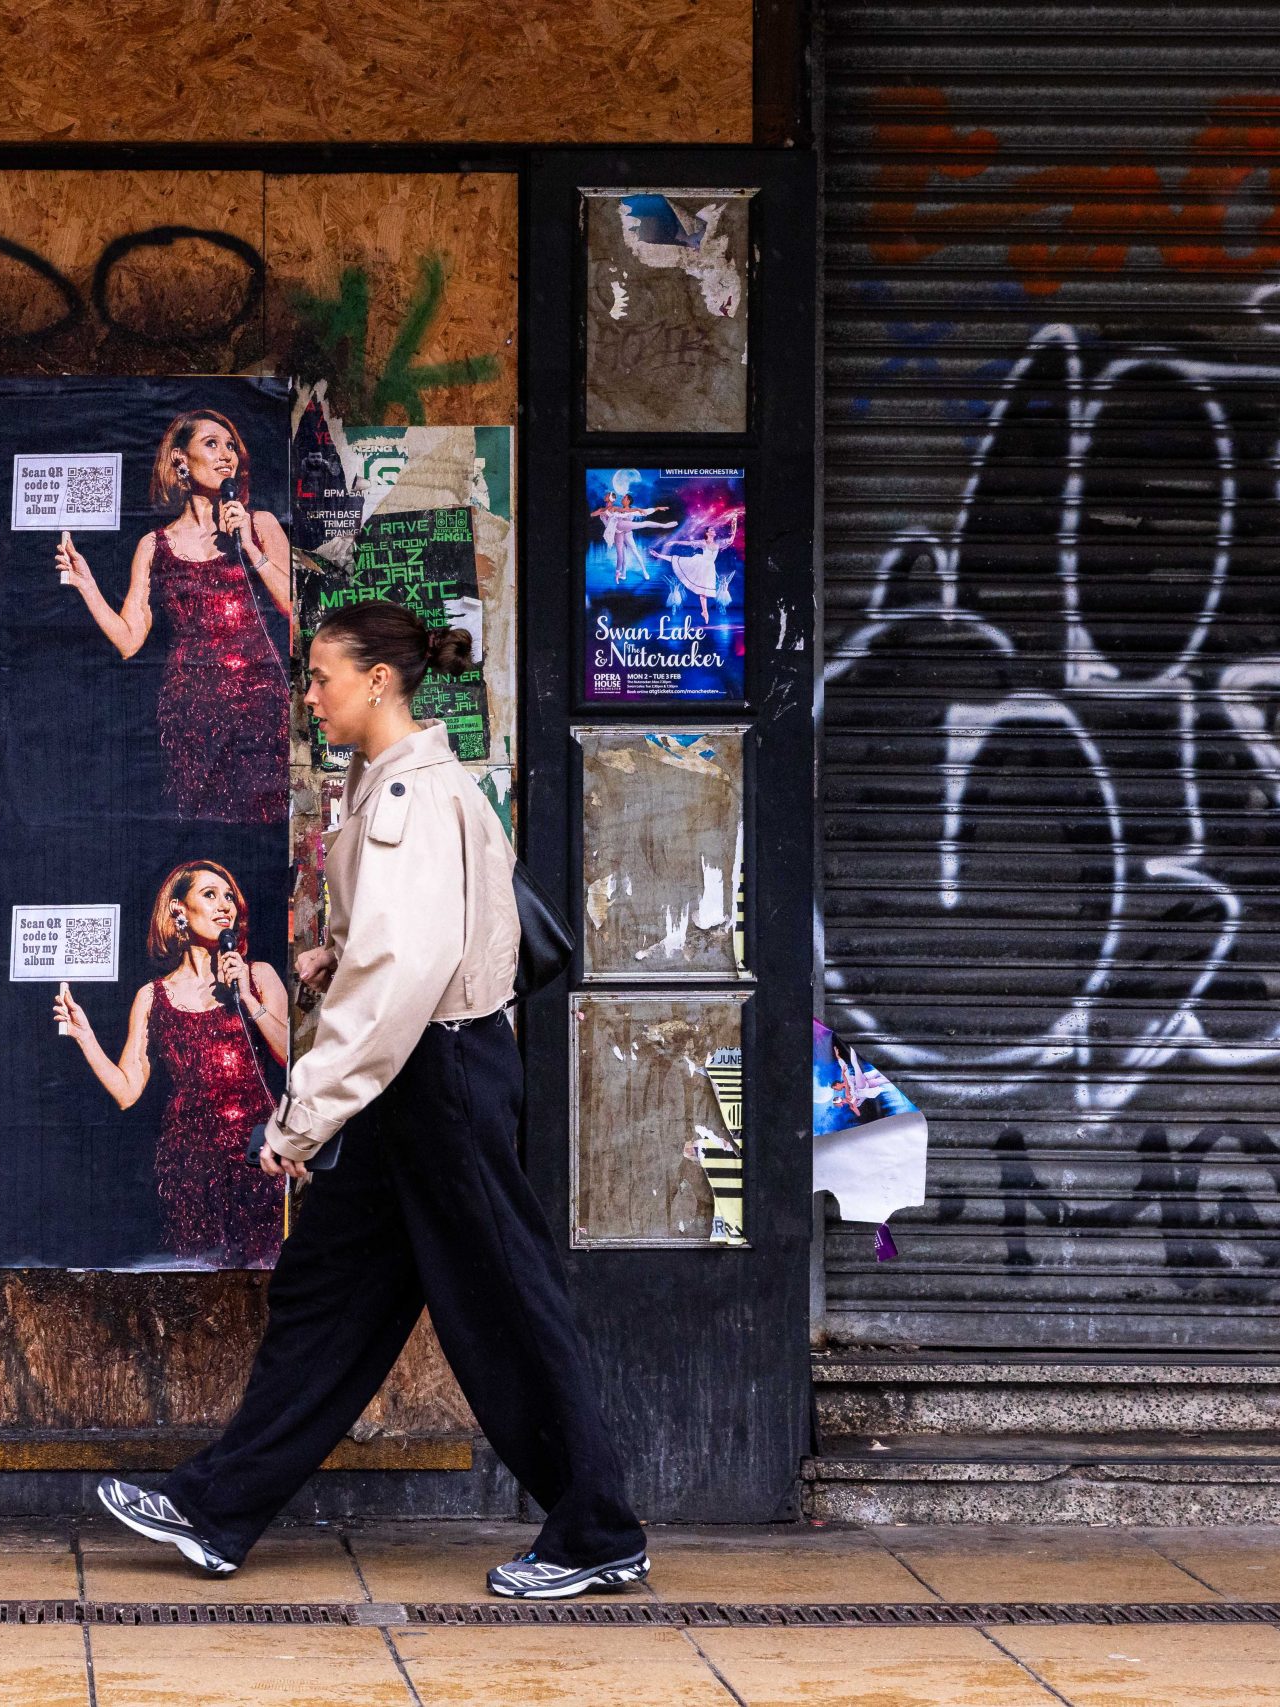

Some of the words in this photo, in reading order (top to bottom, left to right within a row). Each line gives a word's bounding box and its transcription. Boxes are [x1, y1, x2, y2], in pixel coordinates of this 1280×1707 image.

[22, 467, 46, 478] Scan
[48, 467, 63, 478] QR
[24, 480, 48, 490] code
[50, 480, 60, 490] to
[24, 492, 42, 503] buy
[44, 494, 59, 503] my
[26, 504, 57, 515] album
[338, 510, 361, 519] BASE
[323, 520, 355, 528] TRIMER
[380, 520, 429, 535] RAVE
[393, 538, 428, 549] ROOM
[376, 566, 425, 585] JAH
[320, 584, 393, 608] MARK
[404, 580, 458, 602] XTC
[595, 615, 652, 641] Swan
[657, 615, 706, 641] Lake
[595, 650, 607, 667] &
[609, 641, 724, 668] Nutcracker
[20, 918, 45, 929] Scan
[46, 918, 62, 929] QR
[22, 931, 46, 941] code
[48, 931, 58, 941] to
[22, 943, 40, 955] buy
[42, 945, 58, 954] my
[24, 955, 55, 966] album
[718, 1054, 743, 1065] JUNE
